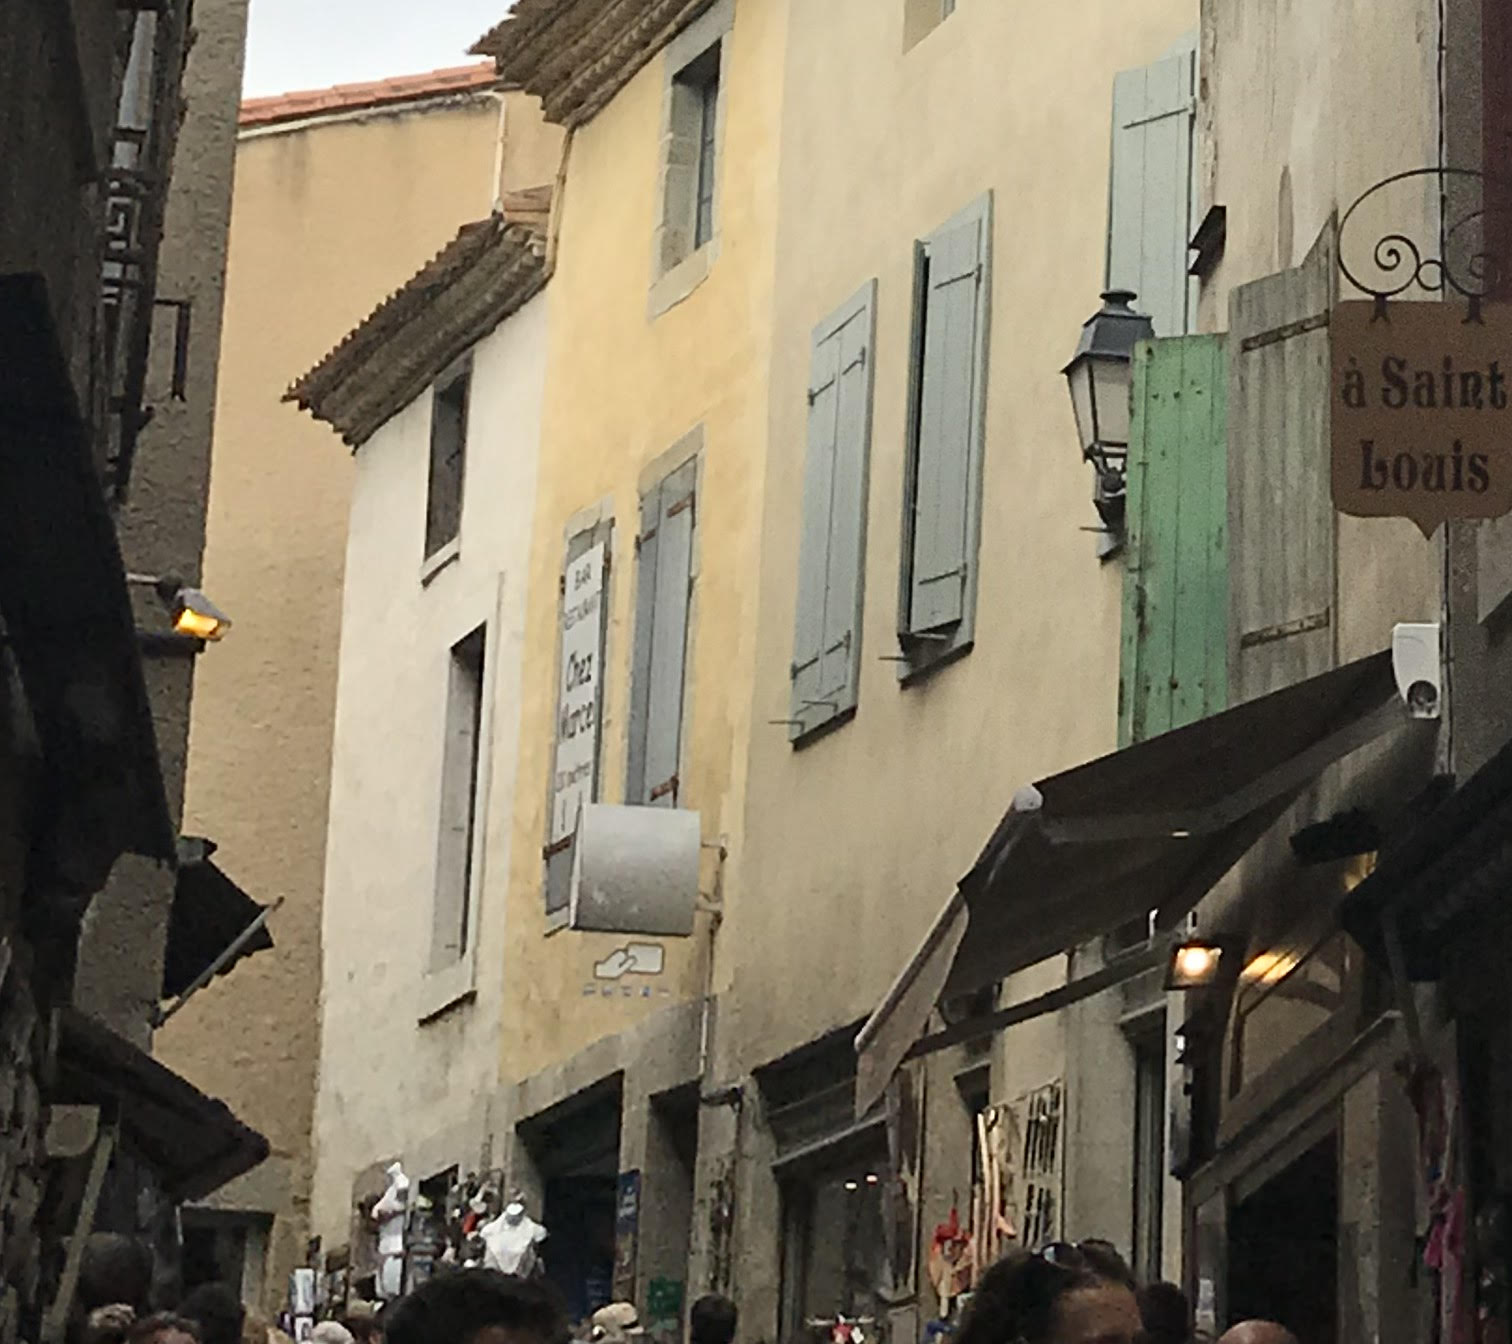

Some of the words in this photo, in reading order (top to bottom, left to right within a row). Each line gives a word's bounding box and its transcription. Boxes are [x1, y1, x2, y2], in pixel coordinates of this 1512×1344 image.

[1342, 357, 1366, 409] à
[1382, 355, 1507, 410] Saint
[1359, 438, 1490, 494] Louis
[573, 562, 592, 592] BAR
[566, 649, 593, 693] Chez
